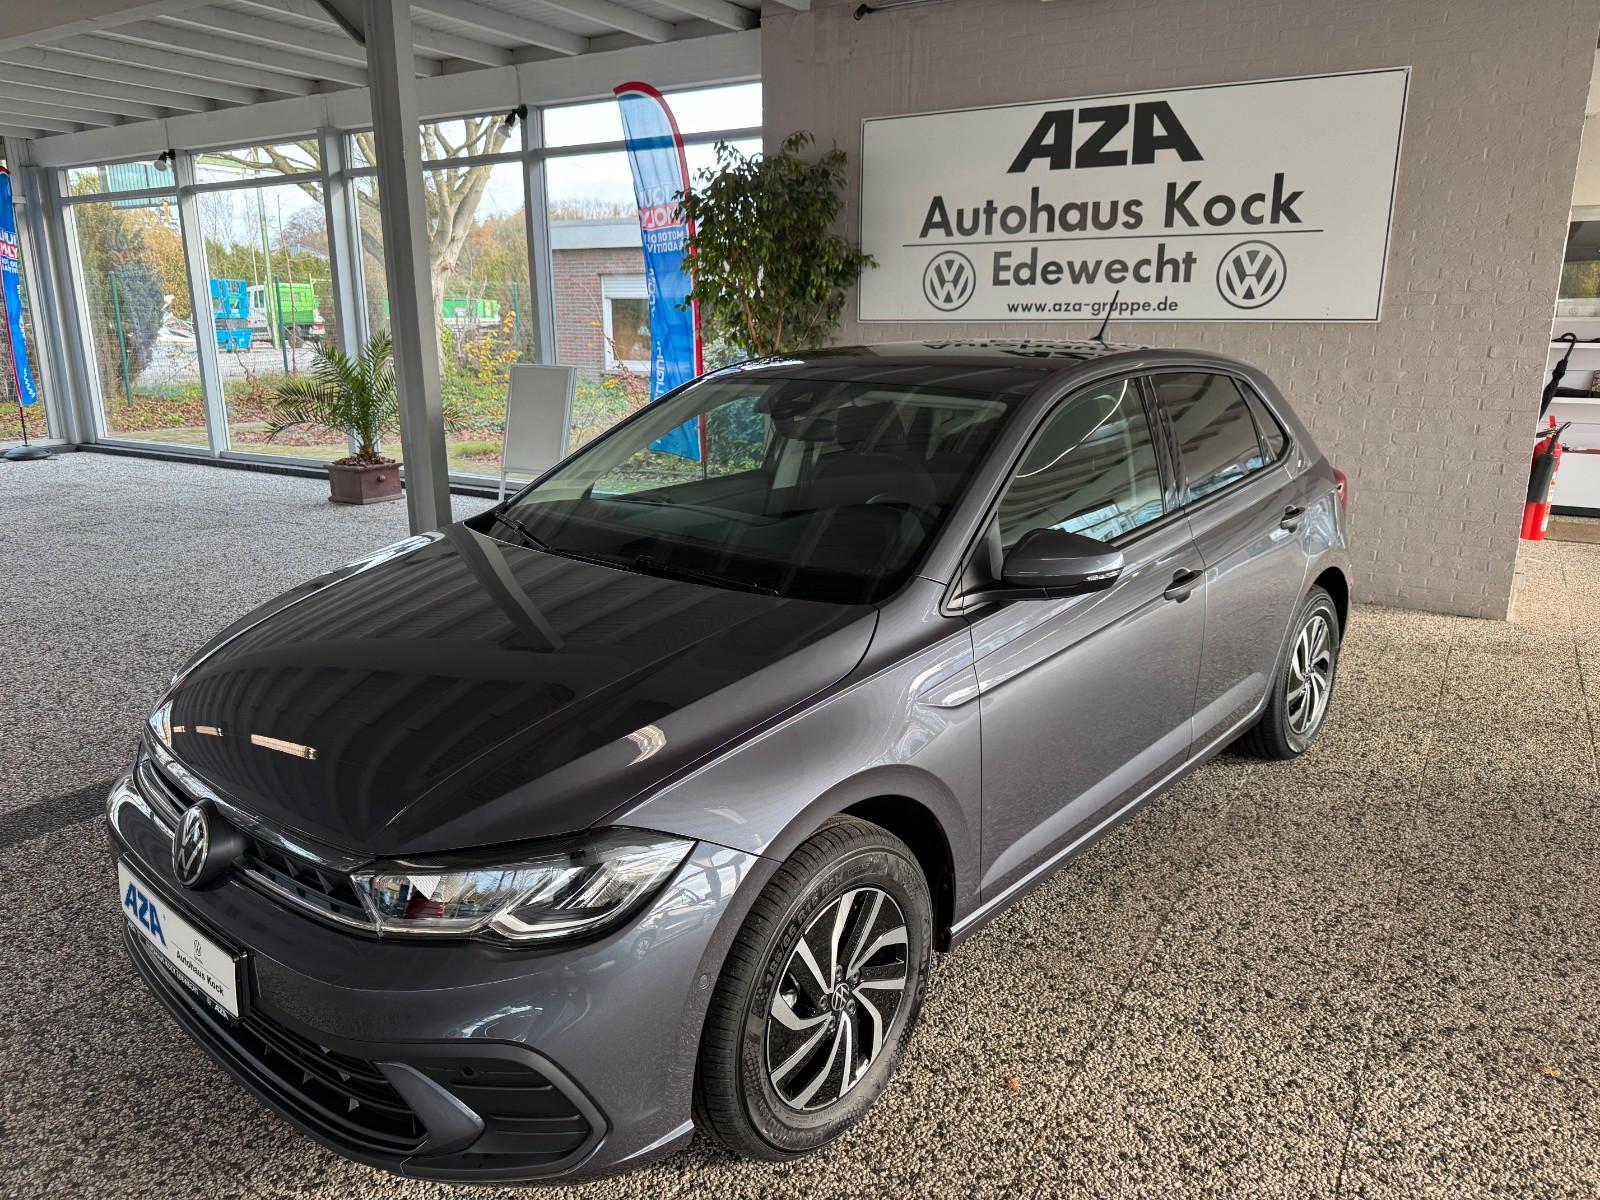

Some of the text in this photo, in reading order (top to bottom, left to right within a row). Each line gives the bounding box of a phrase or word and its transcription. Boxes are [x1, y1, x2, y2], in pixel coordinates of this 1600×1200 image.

[1006, 100, 1204, 174] AZA
[918, 172, 1305, 239] Autohaus Kock
[991, 243, 1197, 287] Edewecht
[1007, 296, 1178, 316] www.aza-gruppe.de
[124, 881, 168, 948] AZA
[176, 950, 206, 981] Autohaus
[206, 974, 225, 997] Kock
